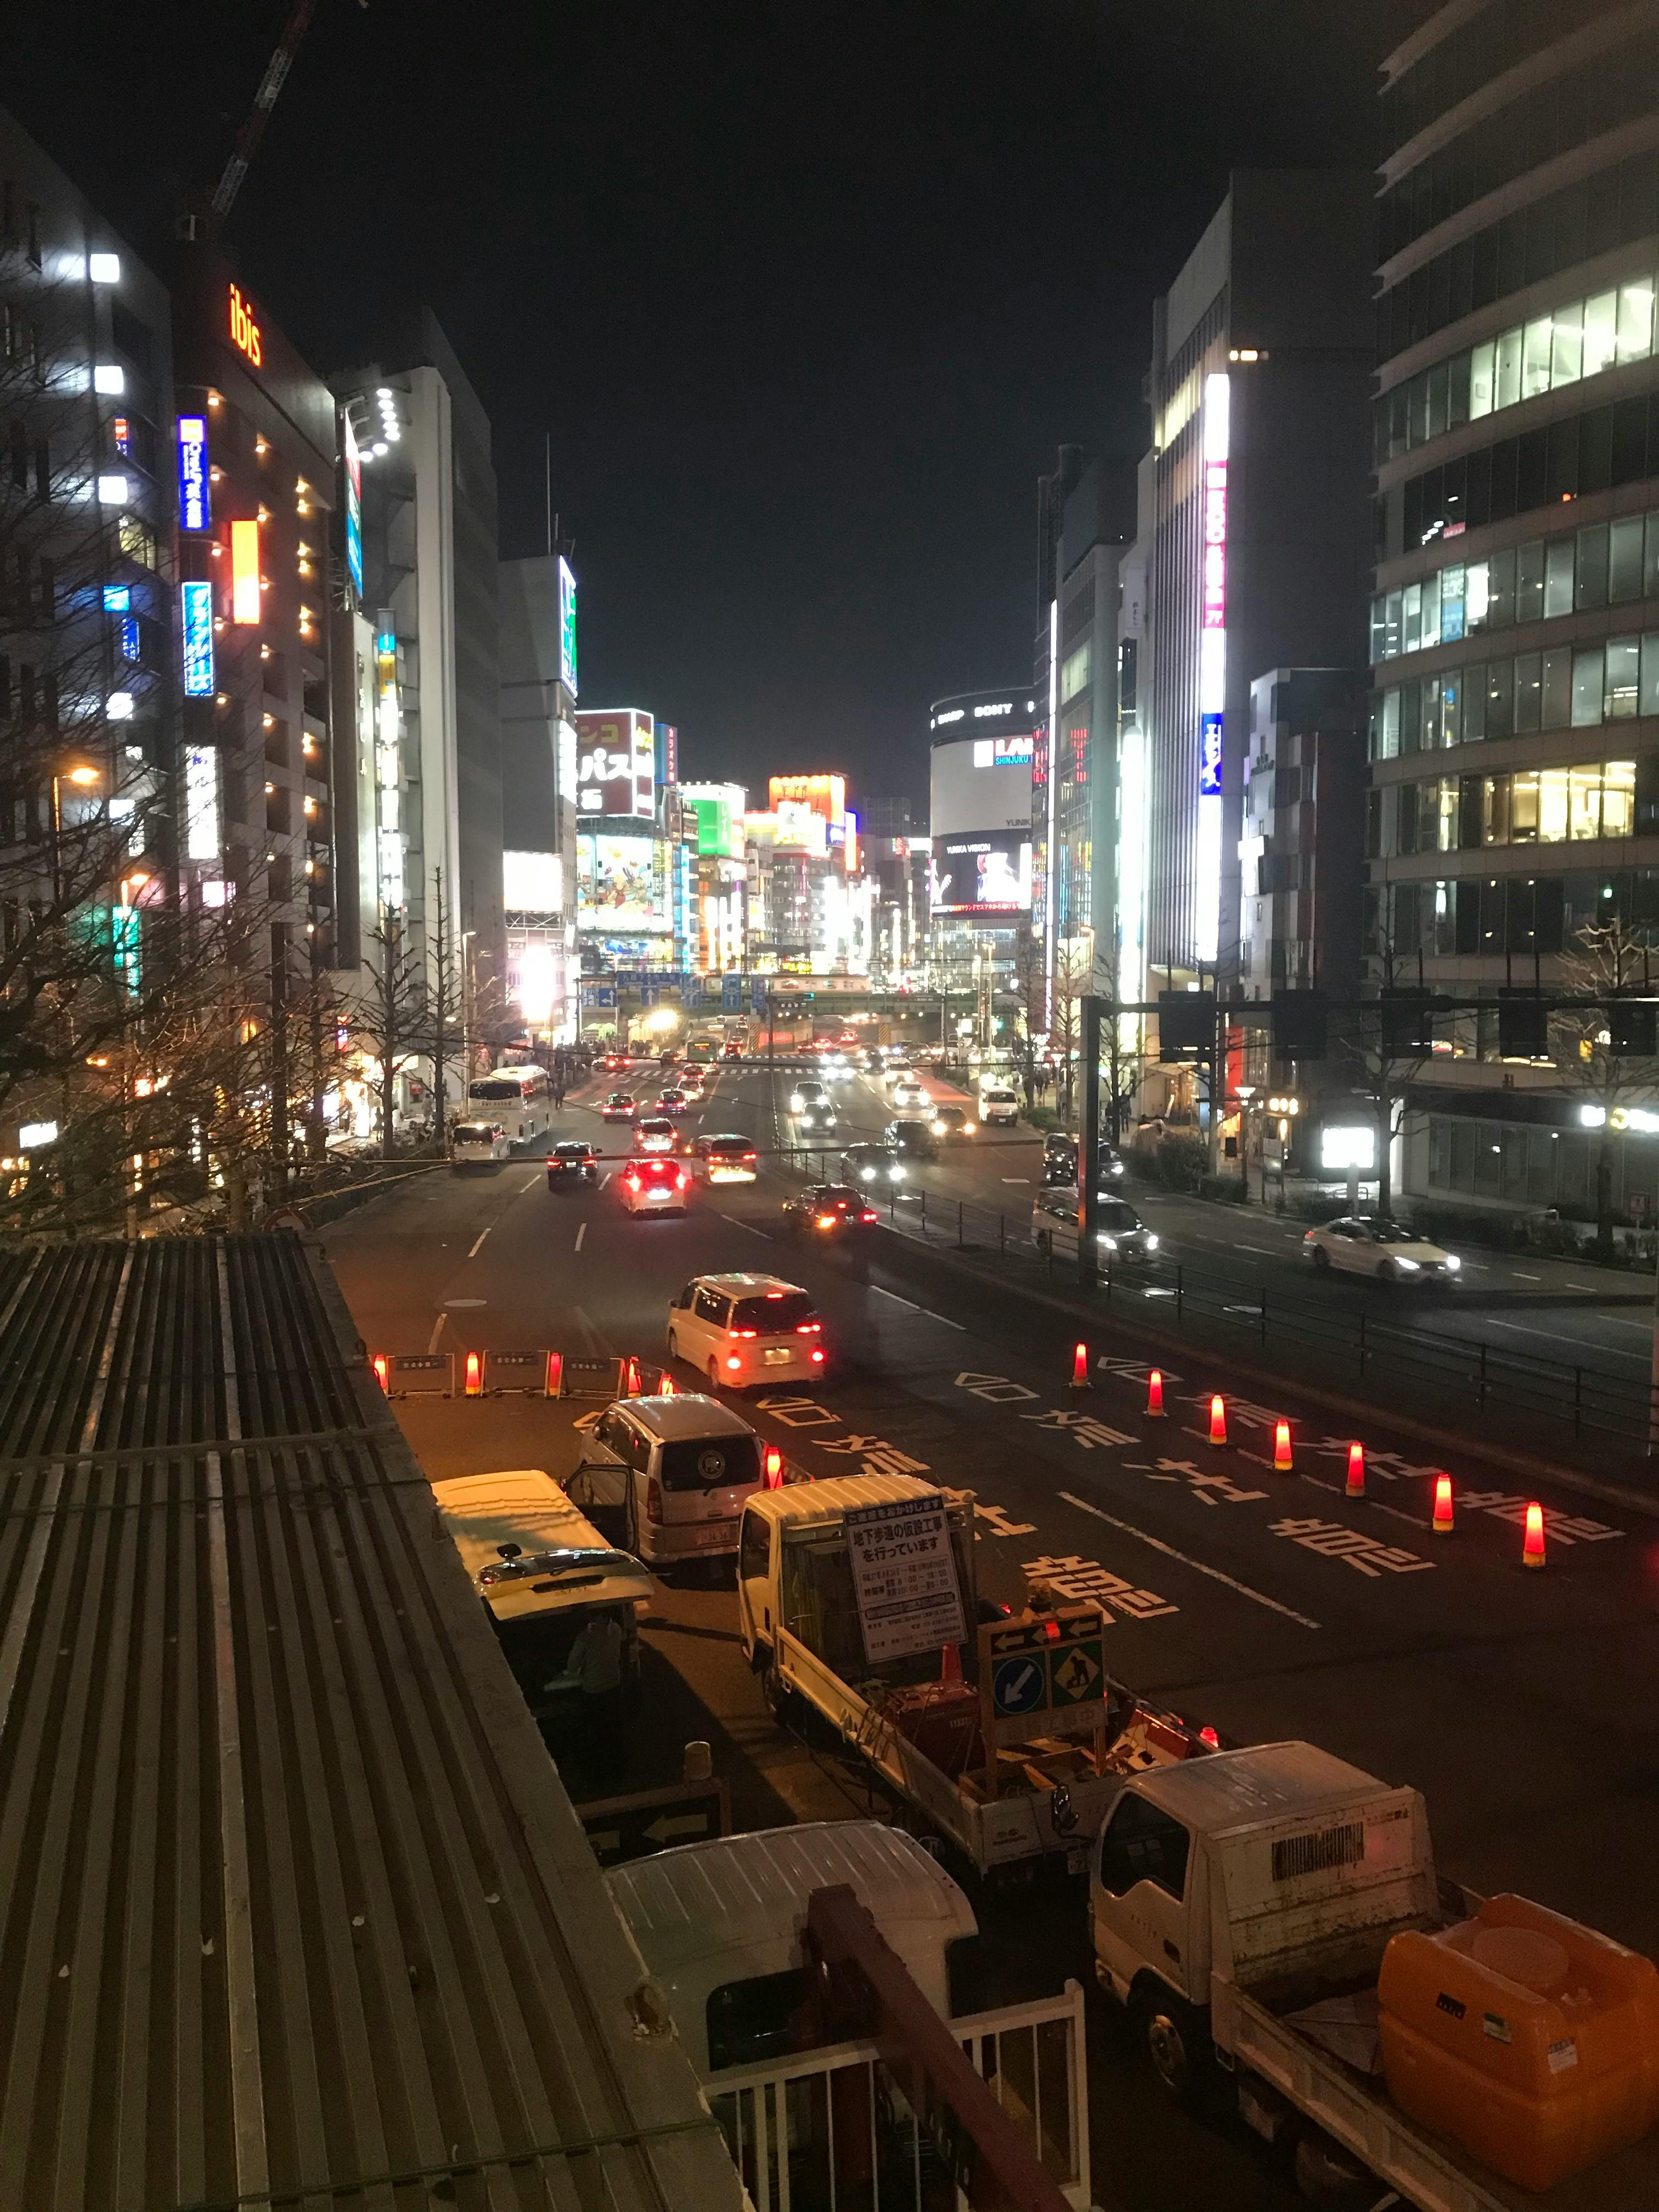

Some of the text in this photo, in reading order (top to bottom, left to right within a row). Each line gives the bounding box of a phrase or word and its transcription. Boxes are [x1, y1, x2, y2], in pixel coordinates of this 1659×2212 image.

[230, 283, 262, 367] ibis
[974, 703, 1012, 717] SONY
[996, 756, 1028, 765] SHINJUKU
[947, 843, 991, 854] YUNIKA VISION
[851, 1515, 944, 1548] 地下歩道の仮設工事
[862, 1535, 940, 1564] を行っています
